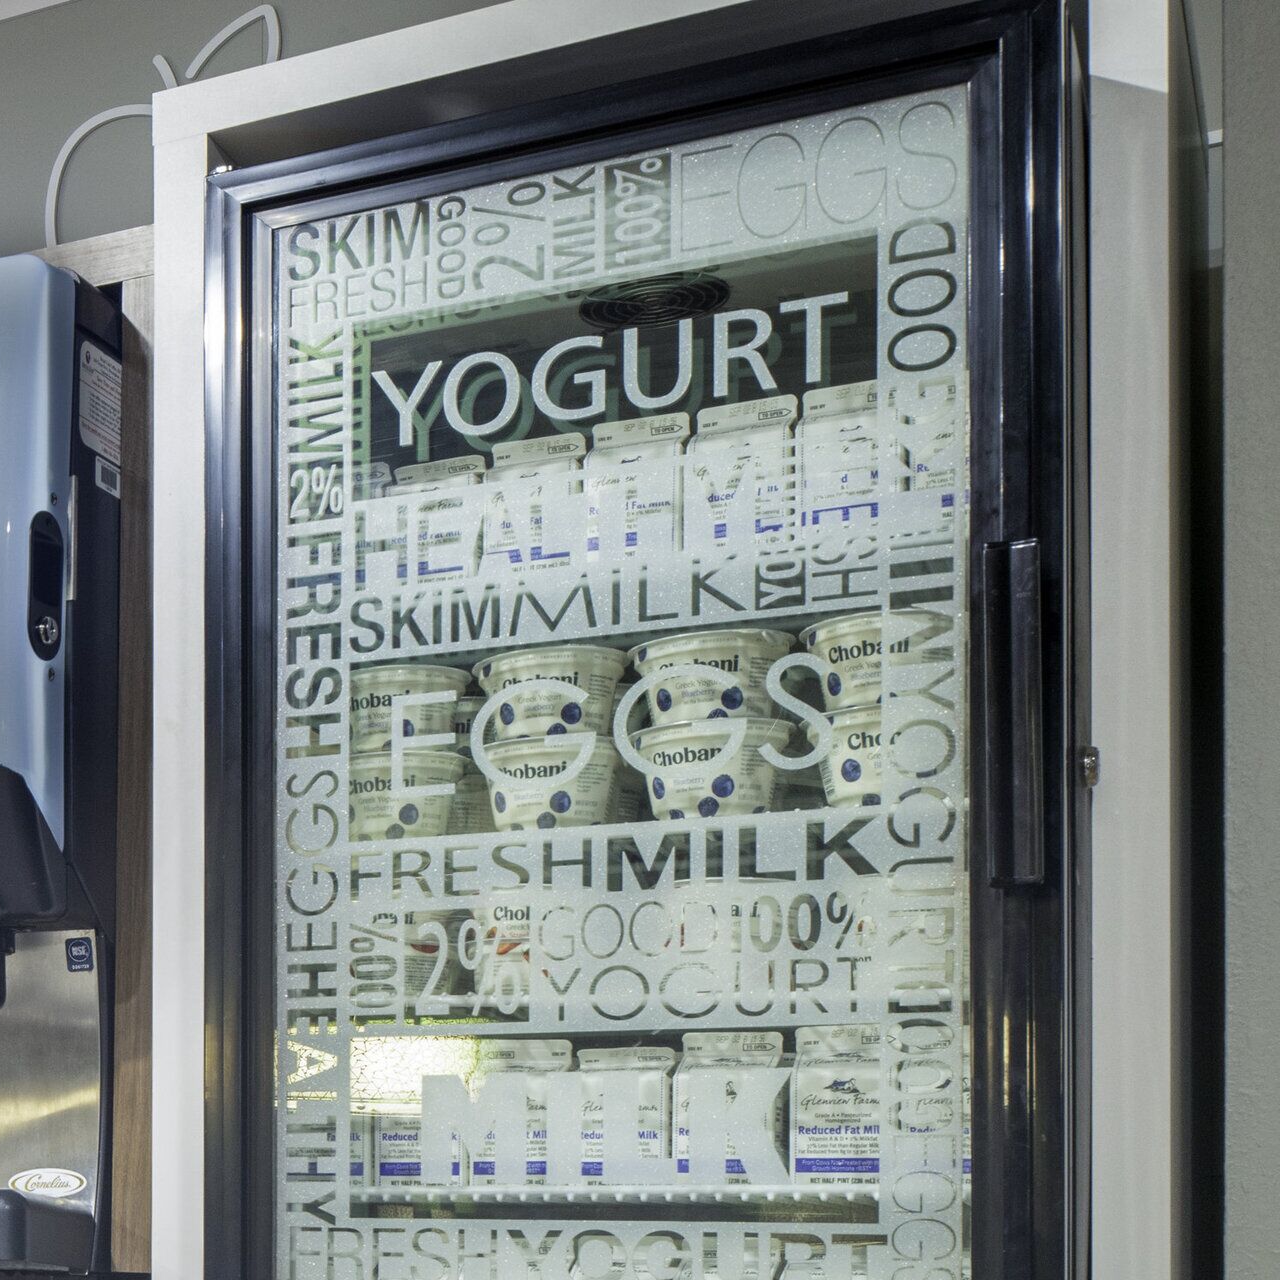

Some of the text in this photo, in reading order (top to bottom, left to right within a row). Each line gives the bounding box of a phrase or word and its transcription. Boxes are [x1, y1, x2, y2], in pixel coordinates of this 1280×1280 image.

[552, 165, 596, 280] MILK
[614, 156, 663, 267] 100%
[680, 100, 958, 252] EGGS
[288, 199, 431, 282] SKIM
[436, 195, 467, 299] GOOD
[288, 261, 428, 328] FRESH
[288, 326, 344, 455] MILK
[371, 291, 849, 448] YOGURT
[290, 462, 344, 522] 2%
[286, 531, 343, 761] FRESH
[391, 652, 834, 797] EGGS
[285, 767, 340, 952] EGGS
[886, 667, 956, 983] YOGURT
[414, 918, 521, 1017] 2%
[540, 900, 719, 961] GOOD
[542, 956, 871, 1021] YOGURT
[285, 961, 339, 1227] HEALTHY
[382, 1132, 419, 1141] Reduced
[638, 1130, 659, 1139] Milk
[798, 1125, 880, 1135] Reduced Fat Mil
[800, 1091, 880, 1110] Glenview Farm
[25, 1174, 69, 1192] Cornelius
